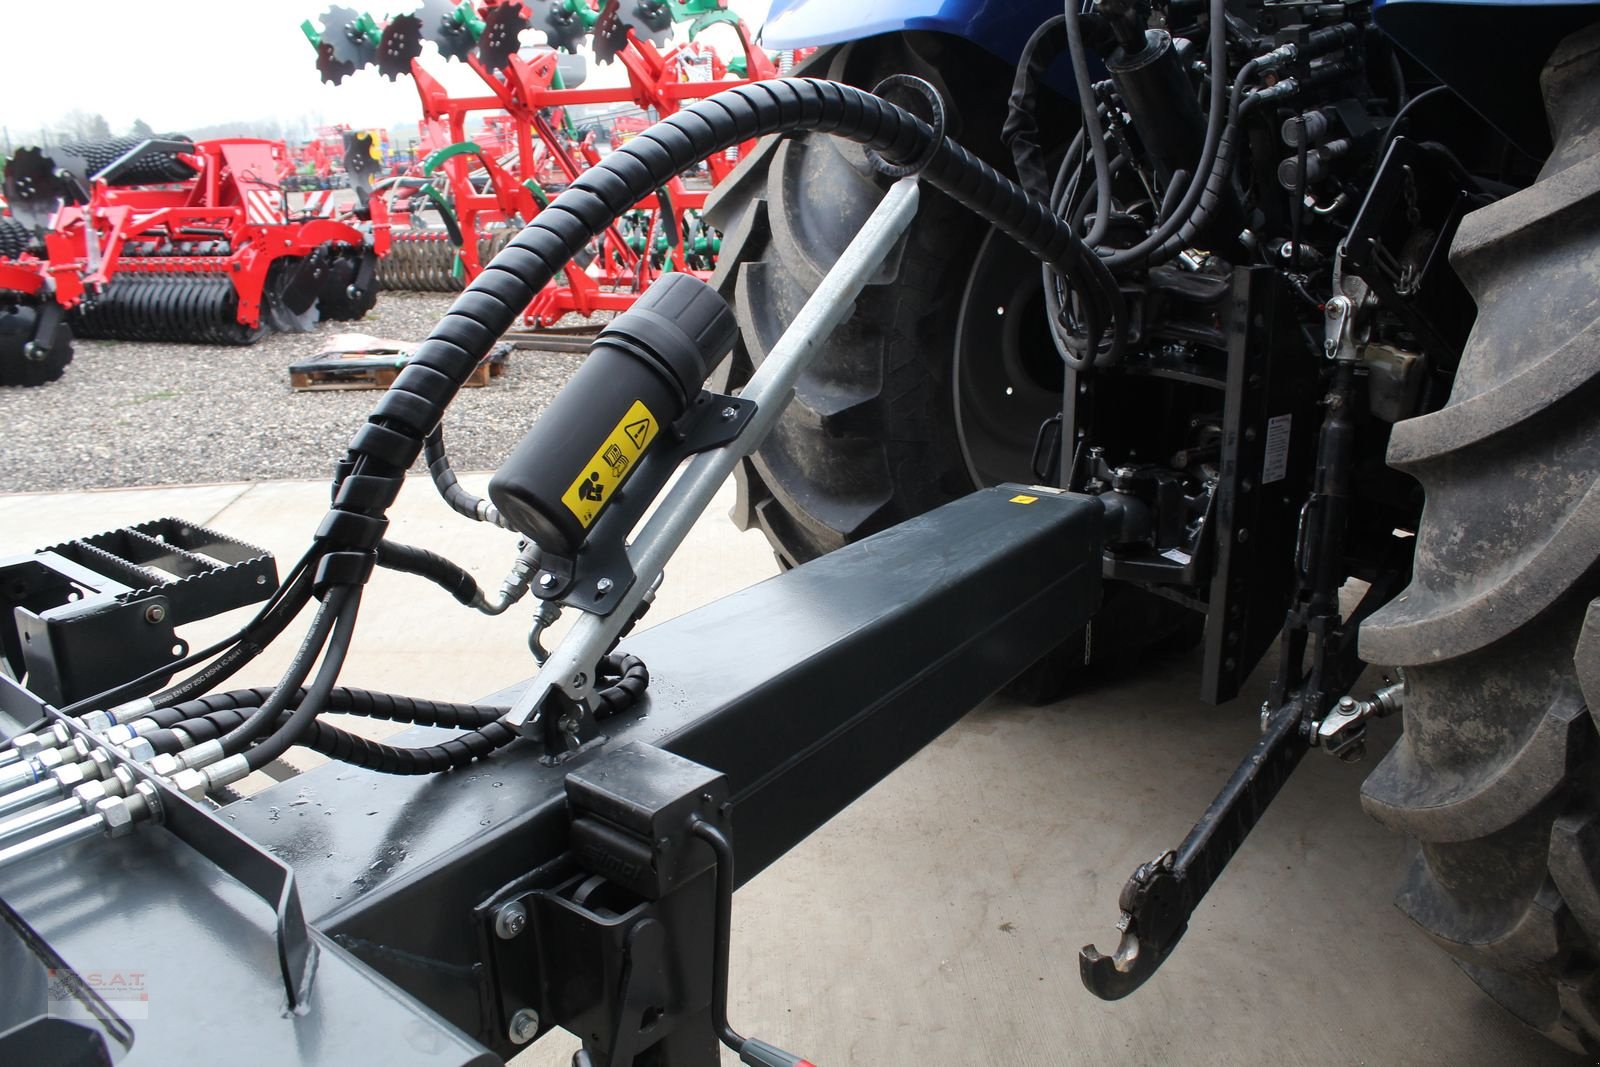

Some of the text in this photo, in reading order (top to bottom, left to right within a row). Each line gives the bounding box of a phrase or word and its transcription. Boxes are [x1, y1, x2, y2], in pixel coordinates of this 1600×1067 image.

[172, 688, 184, 698] EN
[192, 675, 206, 686] 2SC
[204, 663, 223, 678] MSHA
